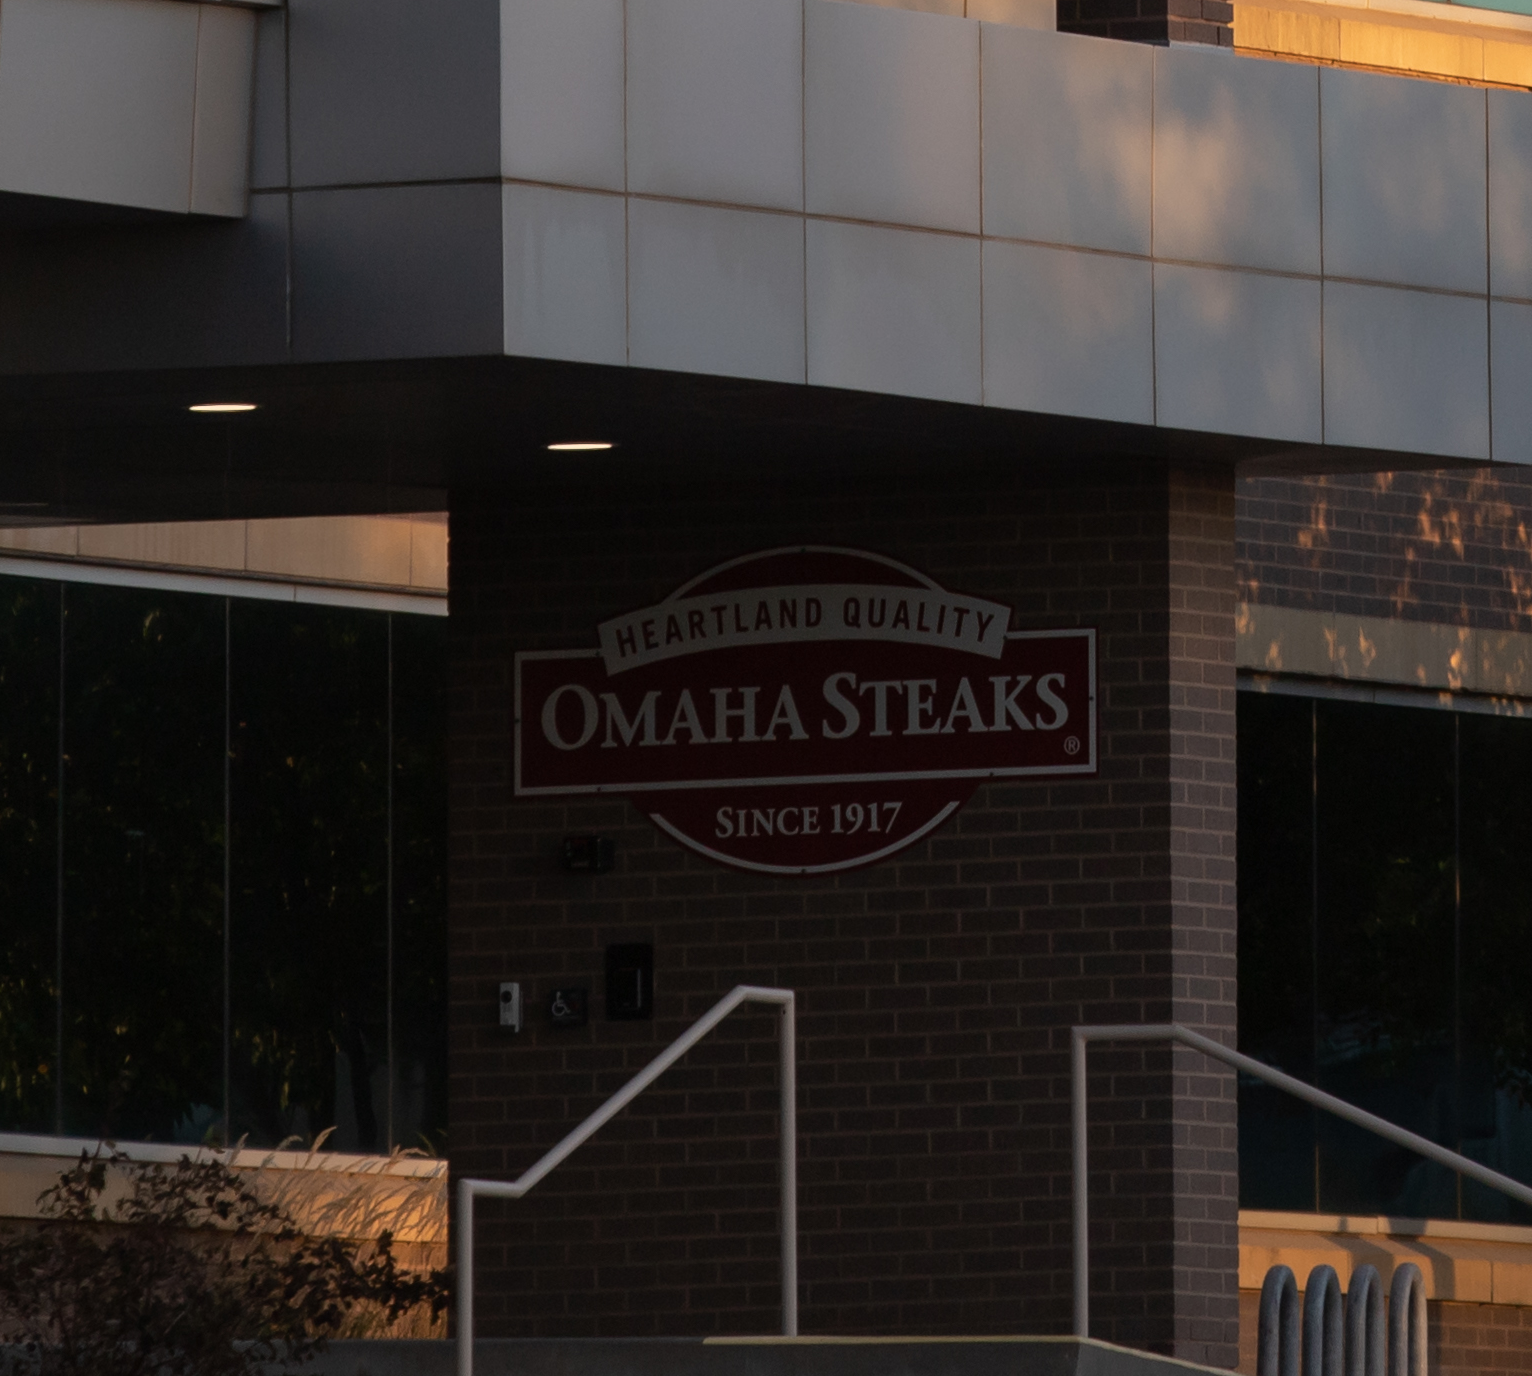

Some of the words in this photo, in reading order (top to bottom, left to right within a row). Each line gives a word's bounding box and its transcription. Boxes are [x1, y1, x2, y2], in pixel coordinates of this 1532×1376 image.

[615, 596, 823, 659] HEARTLAND
[843, 596, 995, 645] QUALITY
[541, 682, 809, 751] OMAHA
[822, 671, 1071, 739] STEAKS
[715, 805, 821, 839] SINCE
[830, 801, 904, 836] 1917
